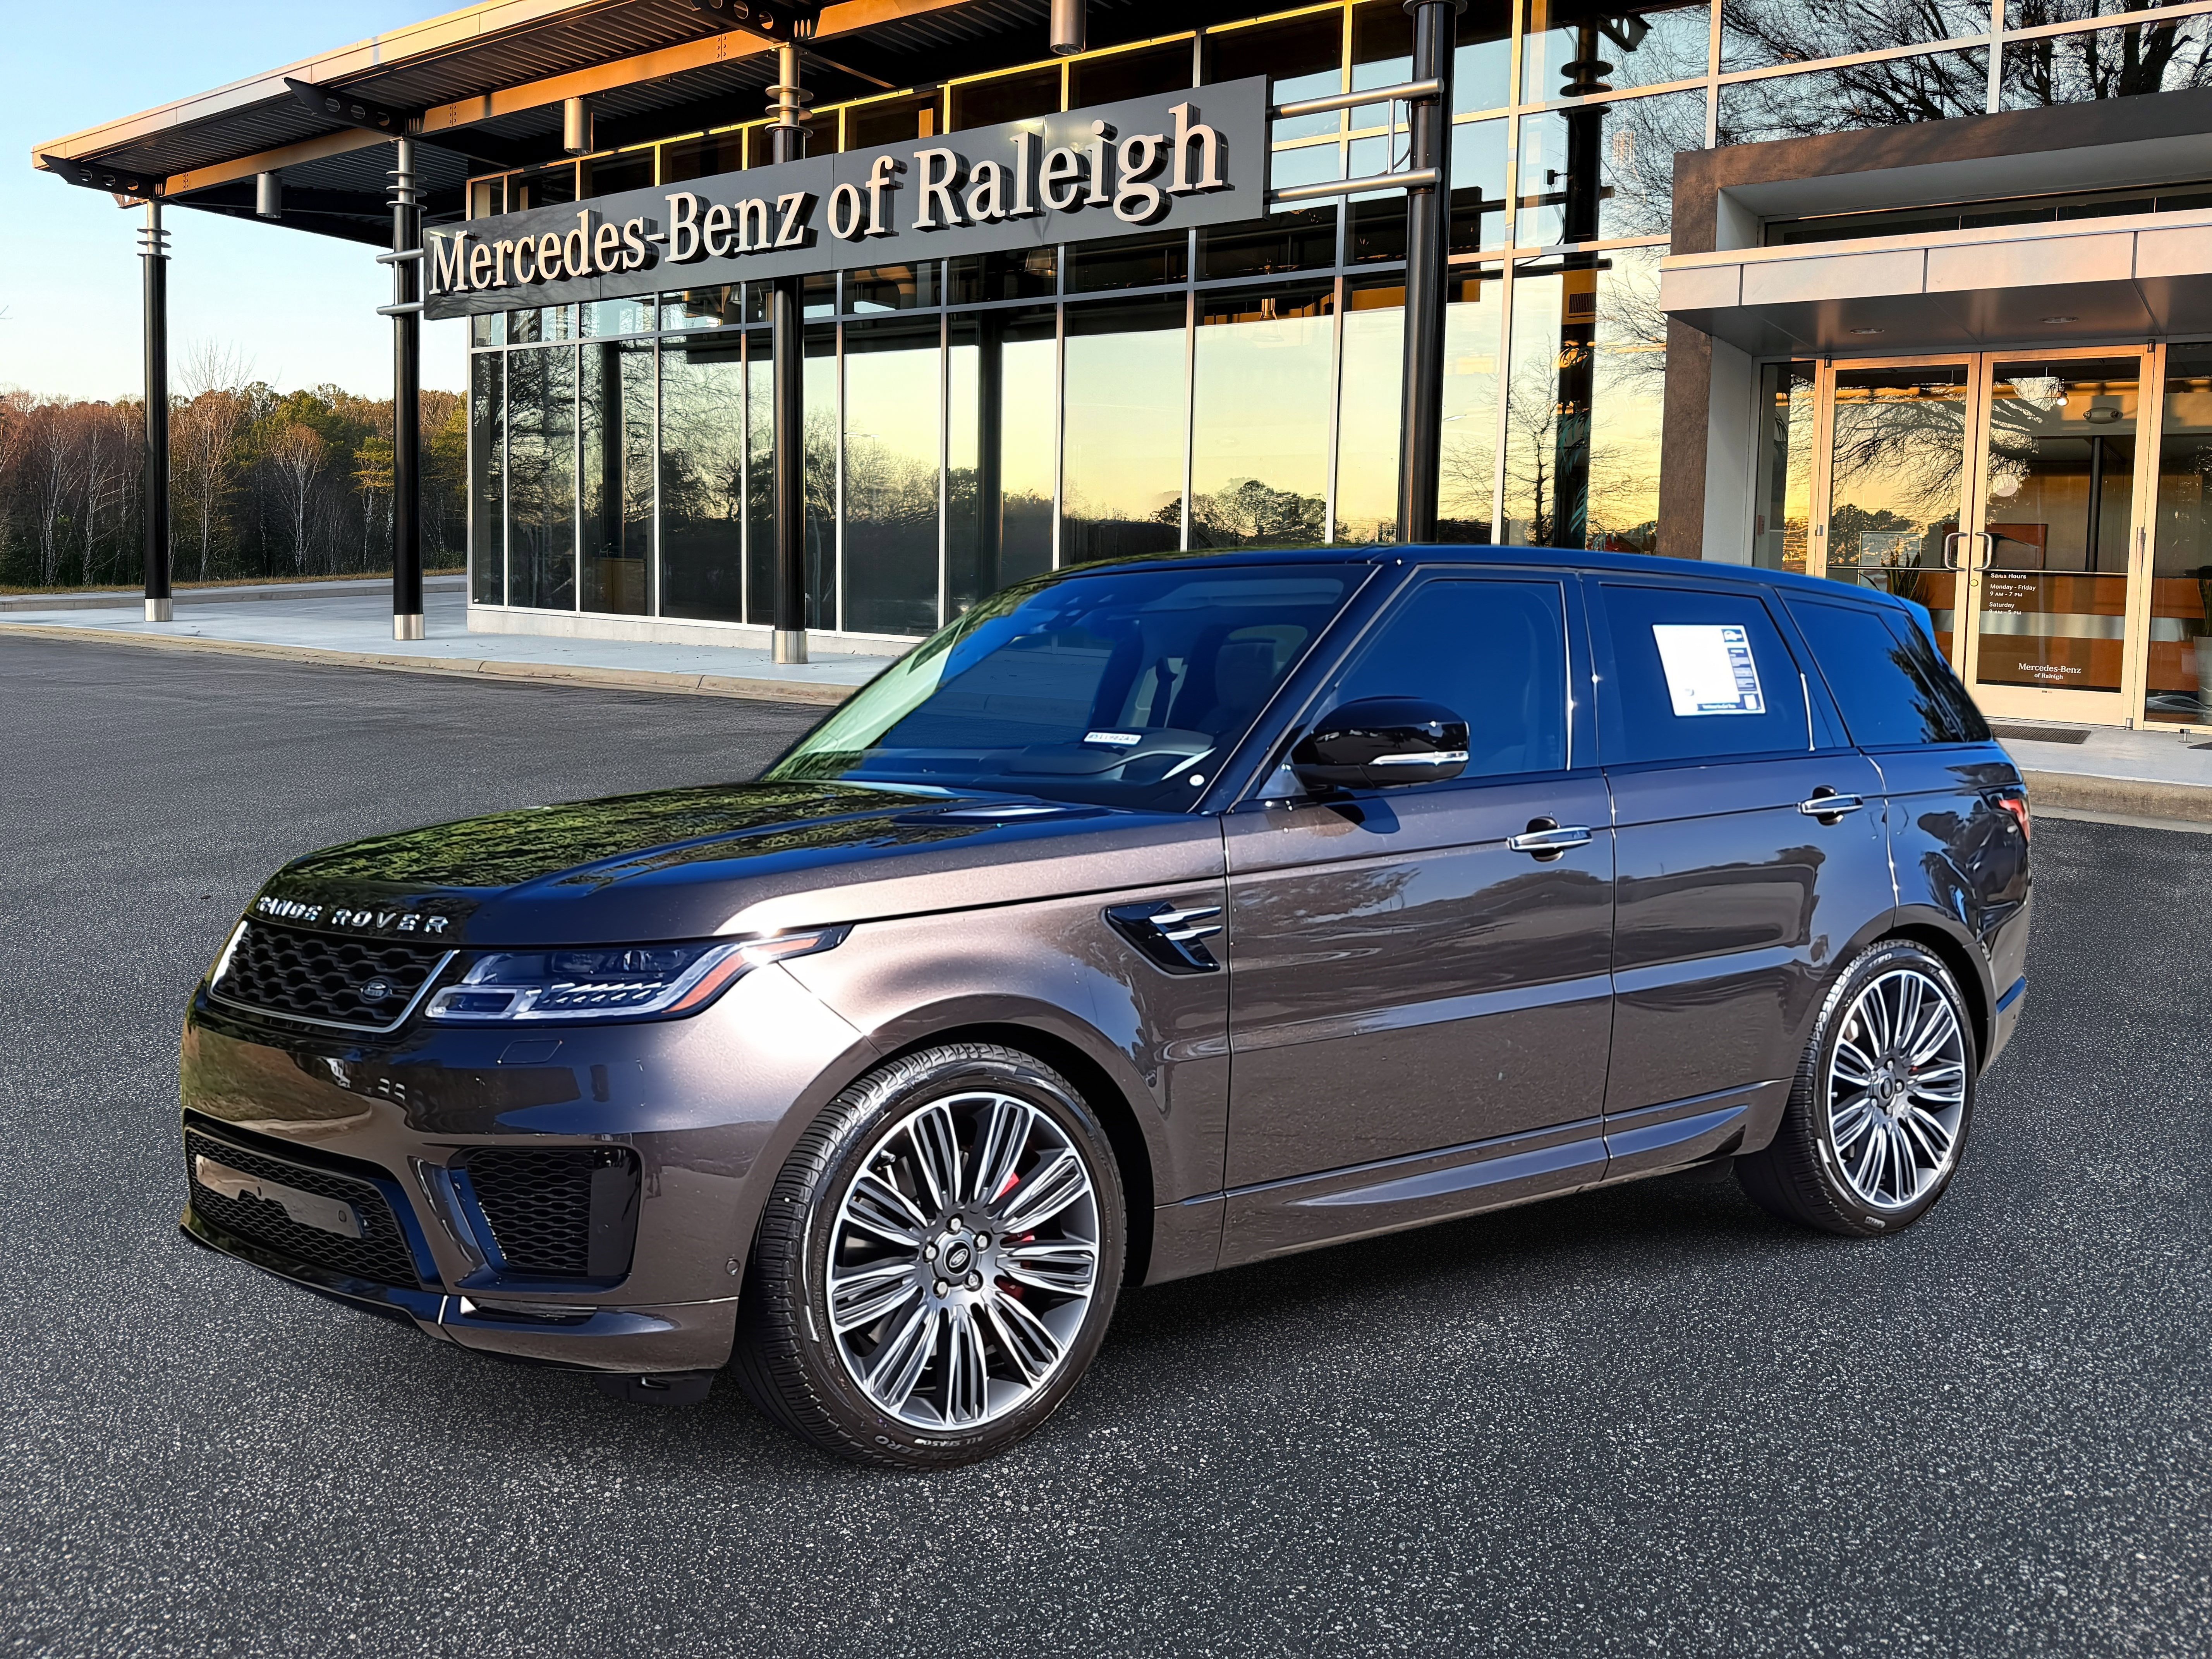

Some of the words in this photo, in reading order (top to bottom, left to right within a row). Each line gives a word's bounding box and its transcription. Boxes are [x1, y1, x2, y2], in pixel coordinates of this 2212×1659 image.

[429, 192, 805, 295] Mercedes-Benz
[827, 155, 894, 239] of
[912, 101, 1223, 222] Raleigh
[2018, 663, 2081, 673] Mercedes-Benz
[331, 908, 448, 933] ROVER
[874, 1435, 925, 1457] ZERO
